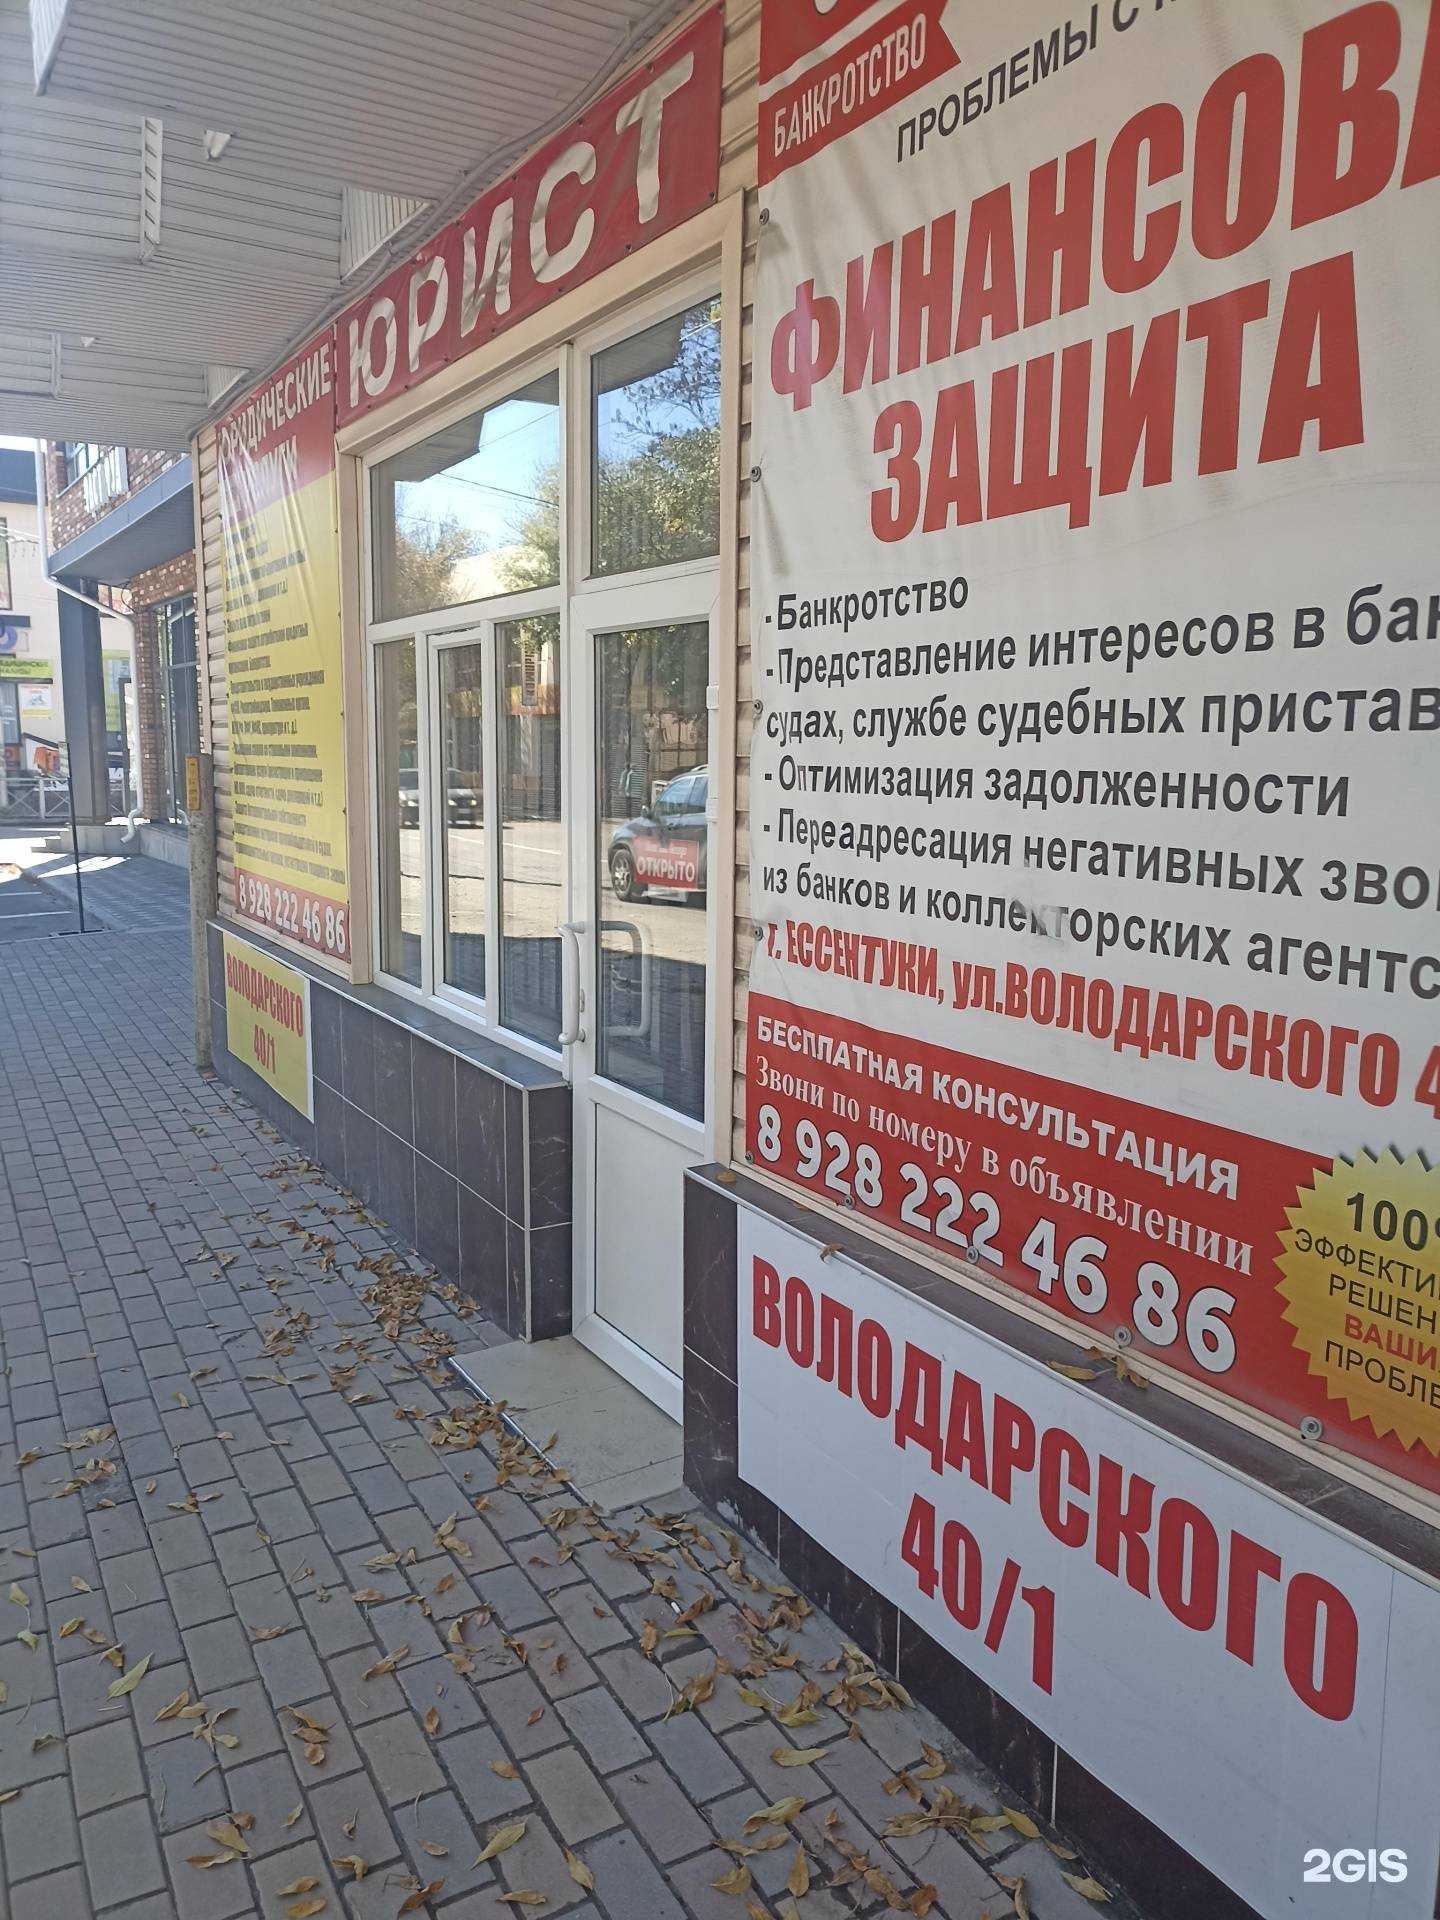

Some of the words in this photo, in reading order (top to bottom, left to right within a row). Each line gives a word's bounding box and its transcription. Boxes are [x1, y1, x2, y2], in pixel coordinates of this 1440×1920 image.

[774, 13, 926, 157] БАНКРОТСТВО
[898, 4, 1098, 163] ПРОБЛЕМЫ
[349, 51, 695, 408] ЮРИСТ
[871, 252, 1364, 543] ЗАЩИТА
[1028, 612, 1275, 673] интересов
[1293, 606, 1325, 649] в
[766, 708, 843, 747] судах,
[853, 694, 967, 747] службе
[977, 686, 1186, 747] судебных
[1201, 686, 1440, 747] пристав
[778, 754, 973, 804] Оптимизация
[983, 768, 1349, 817] задолженности
[778, 807, 1012, 869] Переадресация
[1024, 835, 1305, 898] негативных
[239, 875, 247, 910] 8
[249, 879, 272, 921] 928
[275, 887, 299, 934] 222
[302, 898, 321, 944] 46
[325, 905, 347, 954] 86
[763, 865, 788, 894] из
[796, 861, 890, 910] банков
[899, 884, 916, 915] и
[926, 888, 1232, 966] коллекторских
[785, 919, 945, 1006] ЕССЕНТУКИ,
[226, 952, 304, 1038] ВОЛОДАРСКОГО
[757, 1014, 924, 1095] БЕСПЛАТНАЯ
[932, 1069, 1240, 1201] КОНСУЛЬТАЦИЯ
[755, 1054, 826, 1109] Звони
[831, 1090, 861, 1123] по
[867, 1103, 973, 1175] номеру
[982, 1140, 1000, 1177] в
[1009, 1155, 1254, 1278] объявлении
[757, 1103, 783, 1163] 8
[795, 1117, 884, 1209] 928
[899, 1160, 1005, 1268] 222
[1020, 1216, 1109, 1316] 46
[1132, 1260, 1238, 1374] 86
[1294, 1227, 1440, 1300] ЭФФЕКТИ
[1346, 1191, 1440, 1252] 100
[1328, 1272, 1437, 1335] РЕШЕН
[752, 1254, 1360, 1722] ВОЛОДАРСКОГО
[901, 1492, 1056, 1696] 40/1
